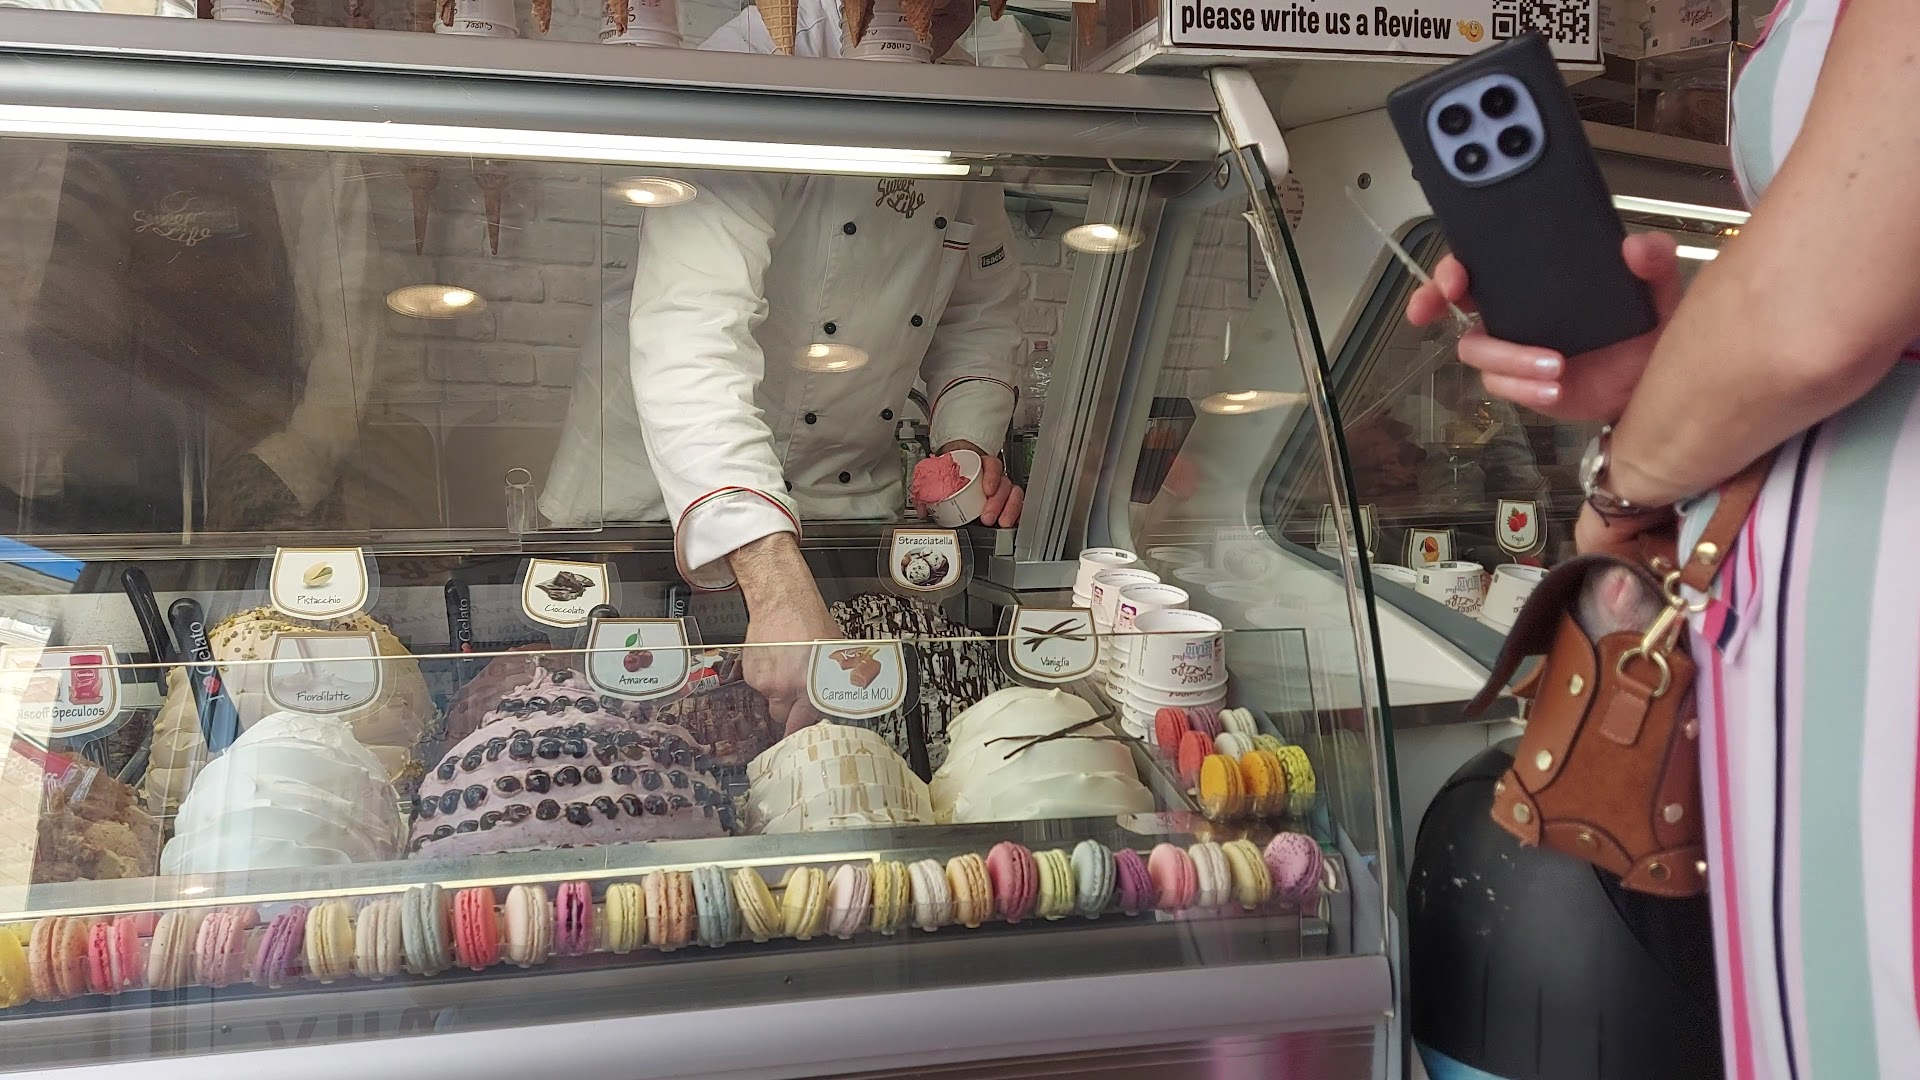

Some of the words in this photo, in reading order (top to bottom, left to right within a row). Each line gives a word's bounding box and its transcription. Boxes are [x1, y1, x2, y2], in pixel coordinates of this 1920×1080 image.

[1181, 0, 1255, 33] please
[1261, 2, 1320, 34] write
[1326, 12, 1350, 36] us
[1356, 13, 1369, 36] a
[1375, 6, 1452, 40] Review
[887, 191, 926, 219] Life
[898, 536, 953, 545] Stracciatella
[296, 595, 342, 604] Pistacchio
[544, 604, 586, 615] Cioccolato
[457, 598, 472, 642] Gelato
[1040, 656, 1070, 672] Vaniglia
[618, 675, 659, 685] Amarena
[296, 690, 352, 702] Fiordilatte
[821, 687, 869, 700] Caramella
[871, 687, 894, 700] MOU
[16, 707, 50, 719] iscoff
[51, 705, 105, 722] Speculoos
